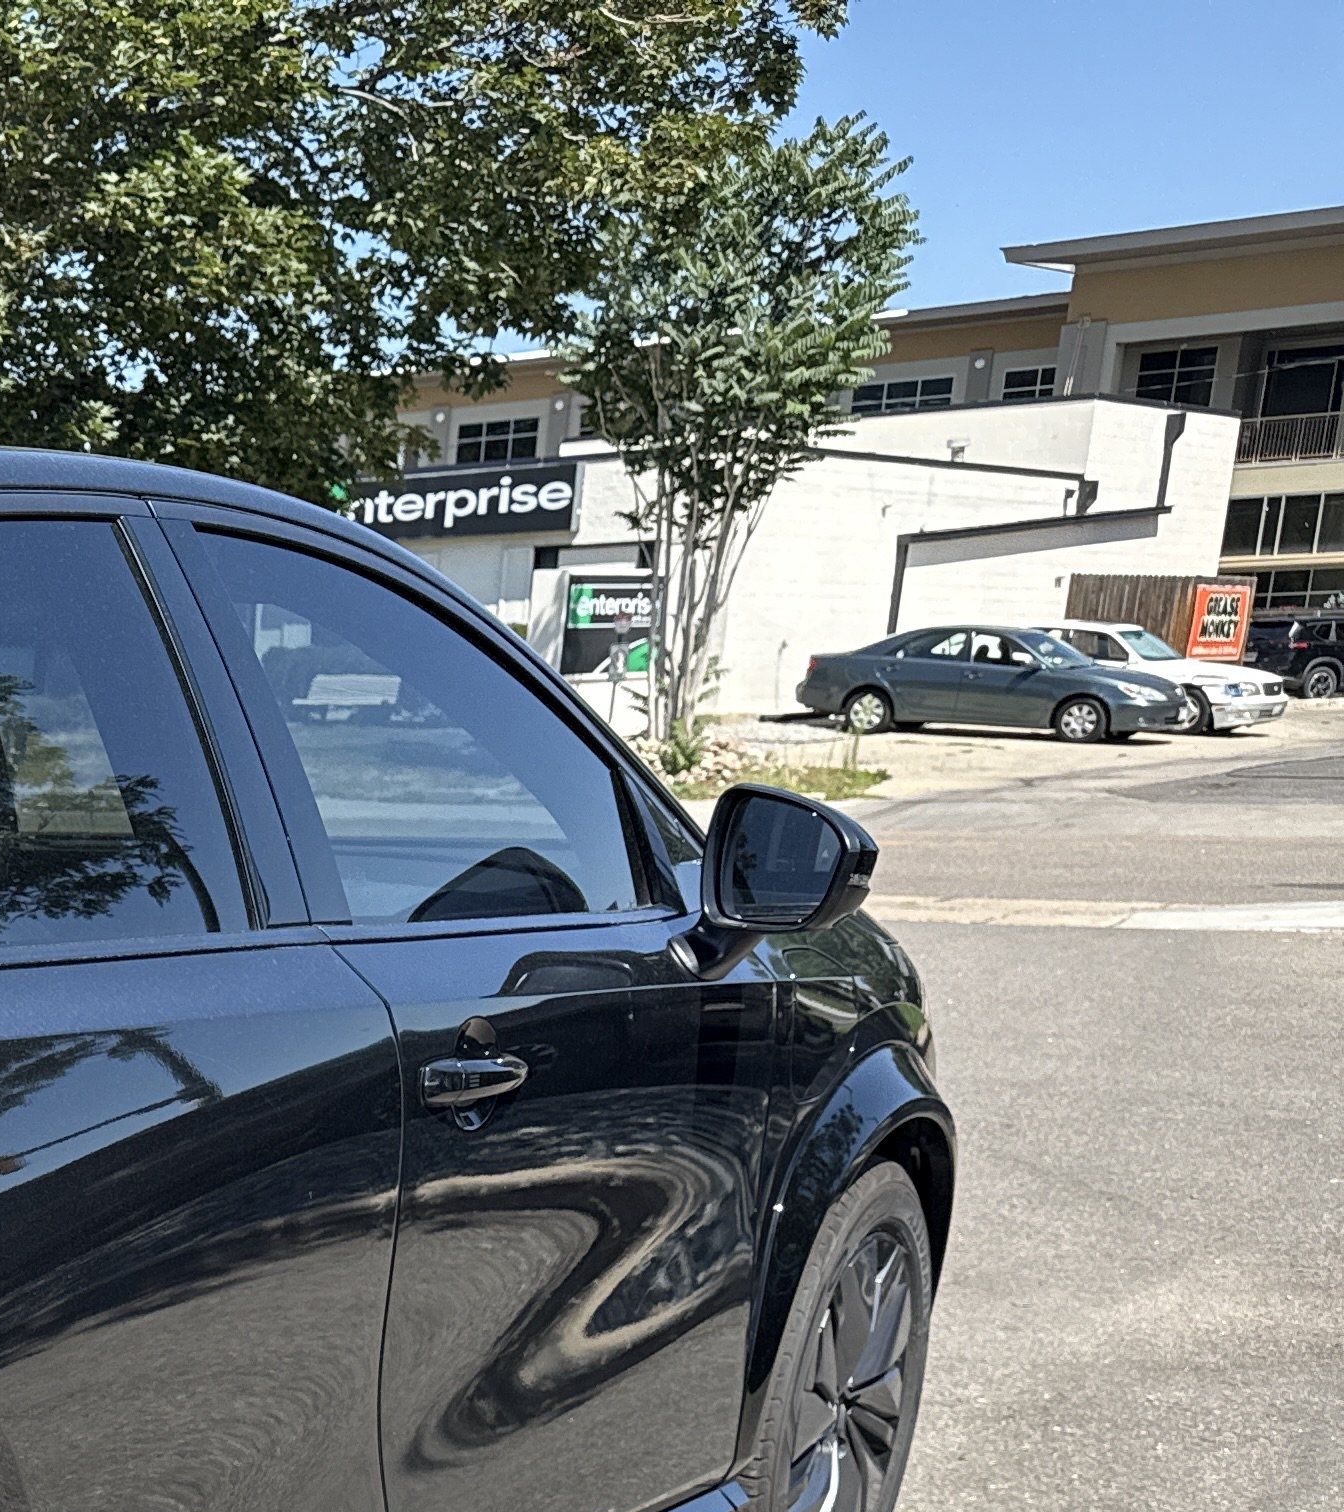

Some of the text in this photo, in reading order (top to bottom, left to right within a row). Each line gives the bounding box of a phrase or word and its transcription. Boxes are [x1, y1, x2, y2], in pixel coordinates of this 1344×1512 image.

[344, 475, 573, 529] nterprise
[576, 591, 659, 616] enterpris
[1206, 596, 1241, 617] GREASE
[1198, 617, 1241, 639] MONKEY
